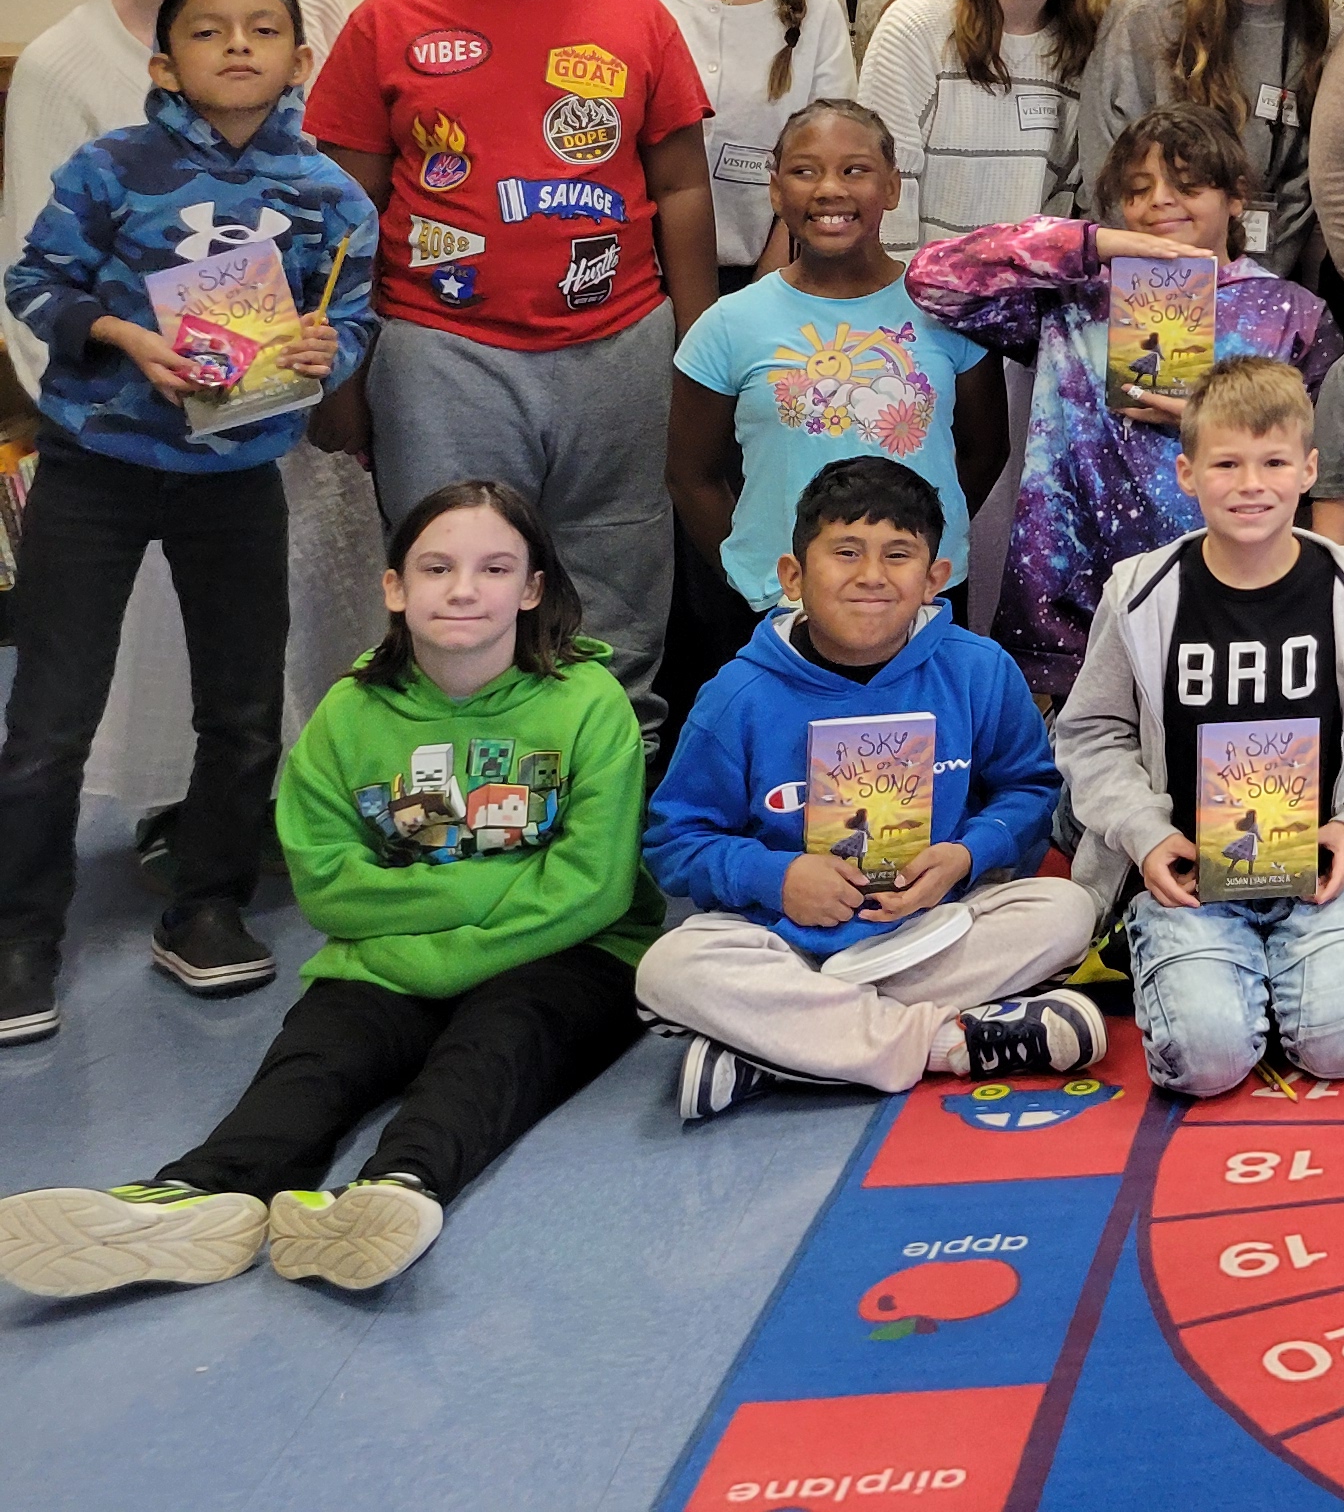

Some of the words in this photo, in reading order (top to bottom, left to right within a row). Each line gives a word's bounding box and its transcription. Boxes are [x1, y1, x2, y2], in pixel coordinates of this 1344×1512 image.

[413, 39, 483, 65] VIBES
[554, 58, 620, 87] GOAT
[563, 128, 608, 148] DOPE
[723, 157, 762, 170] VISITOR
[538, 183, 613, 215] SAVAGE
[199, 258, 249, 291] SKY
[1149, 267, 1192, 291] SKY
[1125, 291, 1162, 311] FULL
[1151, 304, 1204, 332] SONG
[1177, 634, 1318, 706] BRO
[858, 731, 908, 758] SKY
[1245, 731, 1293, 758] SKY
[827, 759, 872, 786] FULL
[1217, 760, 1260, 787] FULL
[859, 774, 920, 805] SONG
[1247, 775, 1307, 807] SONG
[1224, 1149, 1324, 1184] 18
[902, 1233, 1029, 1258] apple
[1218, 1234, 1328, 1278] 19
[727, 1467, 968, 1502] airplane
